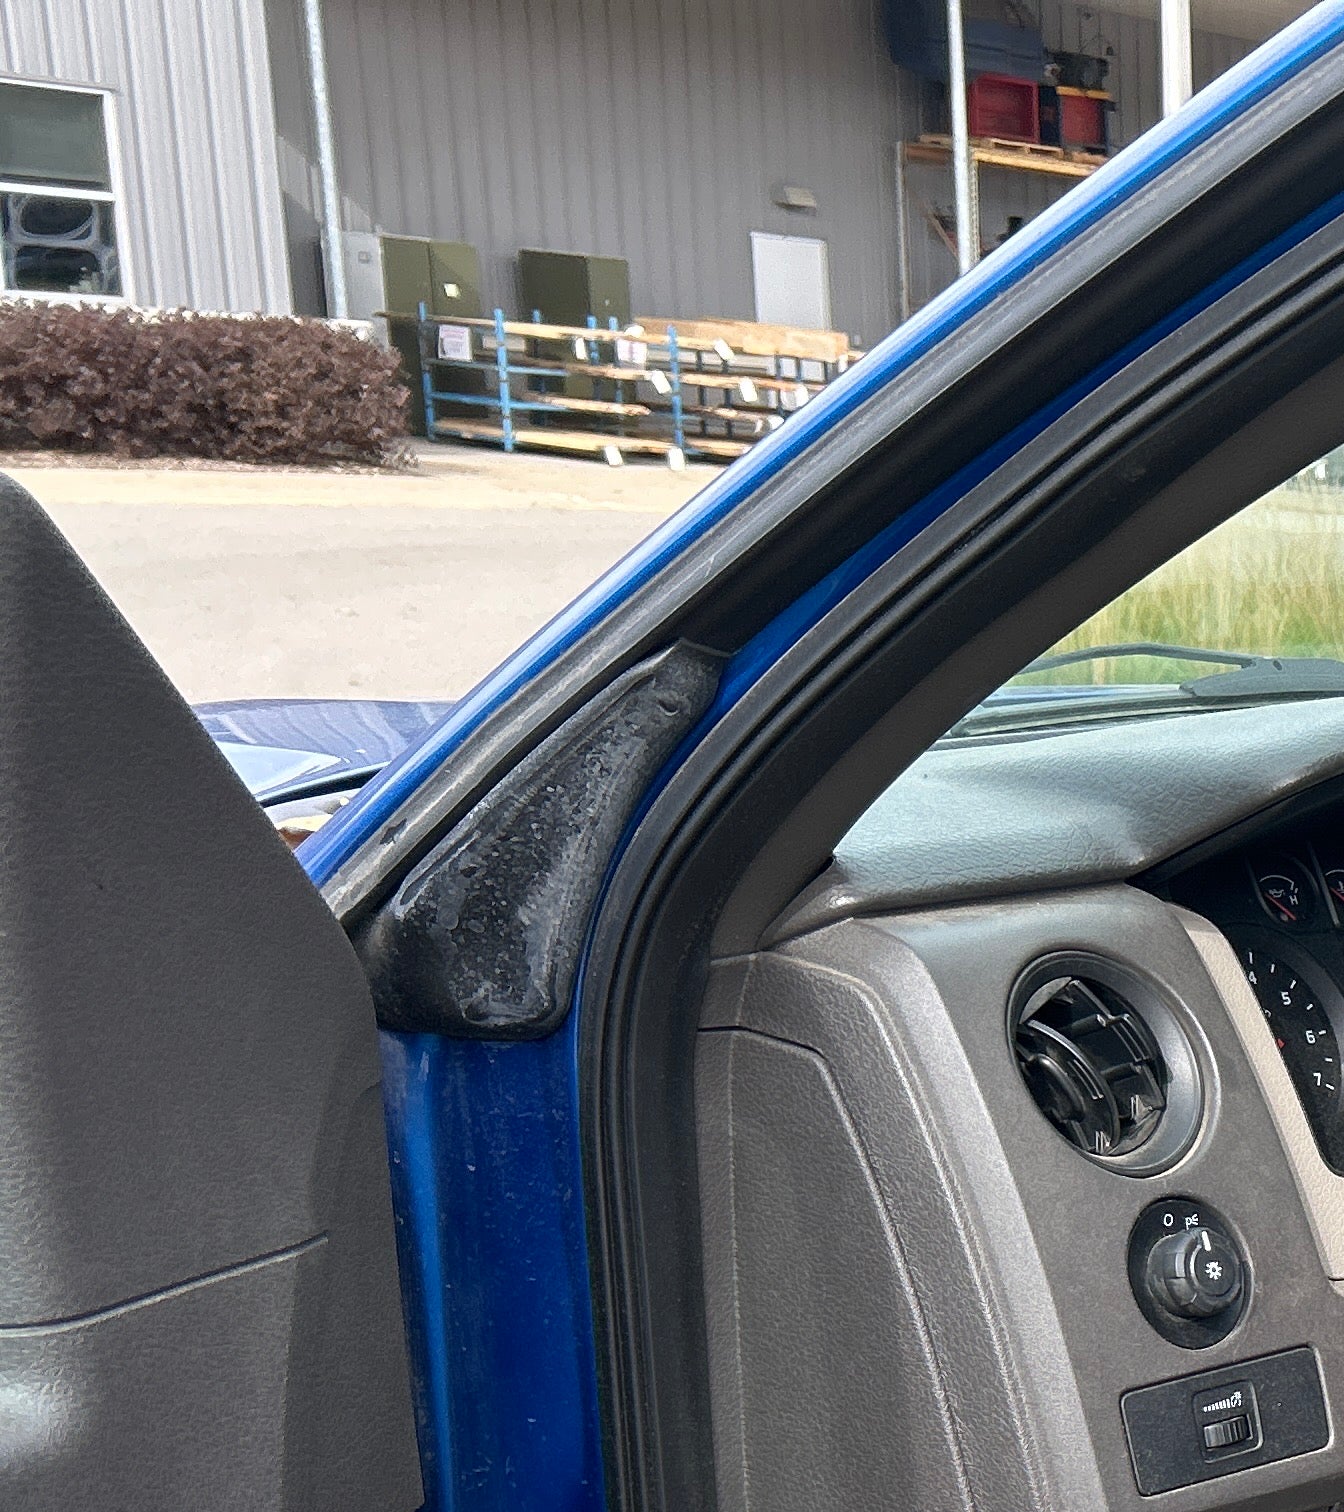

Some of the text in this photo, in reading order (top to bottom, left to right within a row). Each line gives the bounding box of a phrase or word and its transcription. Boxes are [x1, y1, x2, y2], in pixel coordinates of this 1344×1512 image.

[1248, 971, 1258, 985] 4
[1280, 991, 1292, 1006] 5
[1305, 1029, 1316, 1045] 6
[1313, 1072, 1322, 1086] 7
